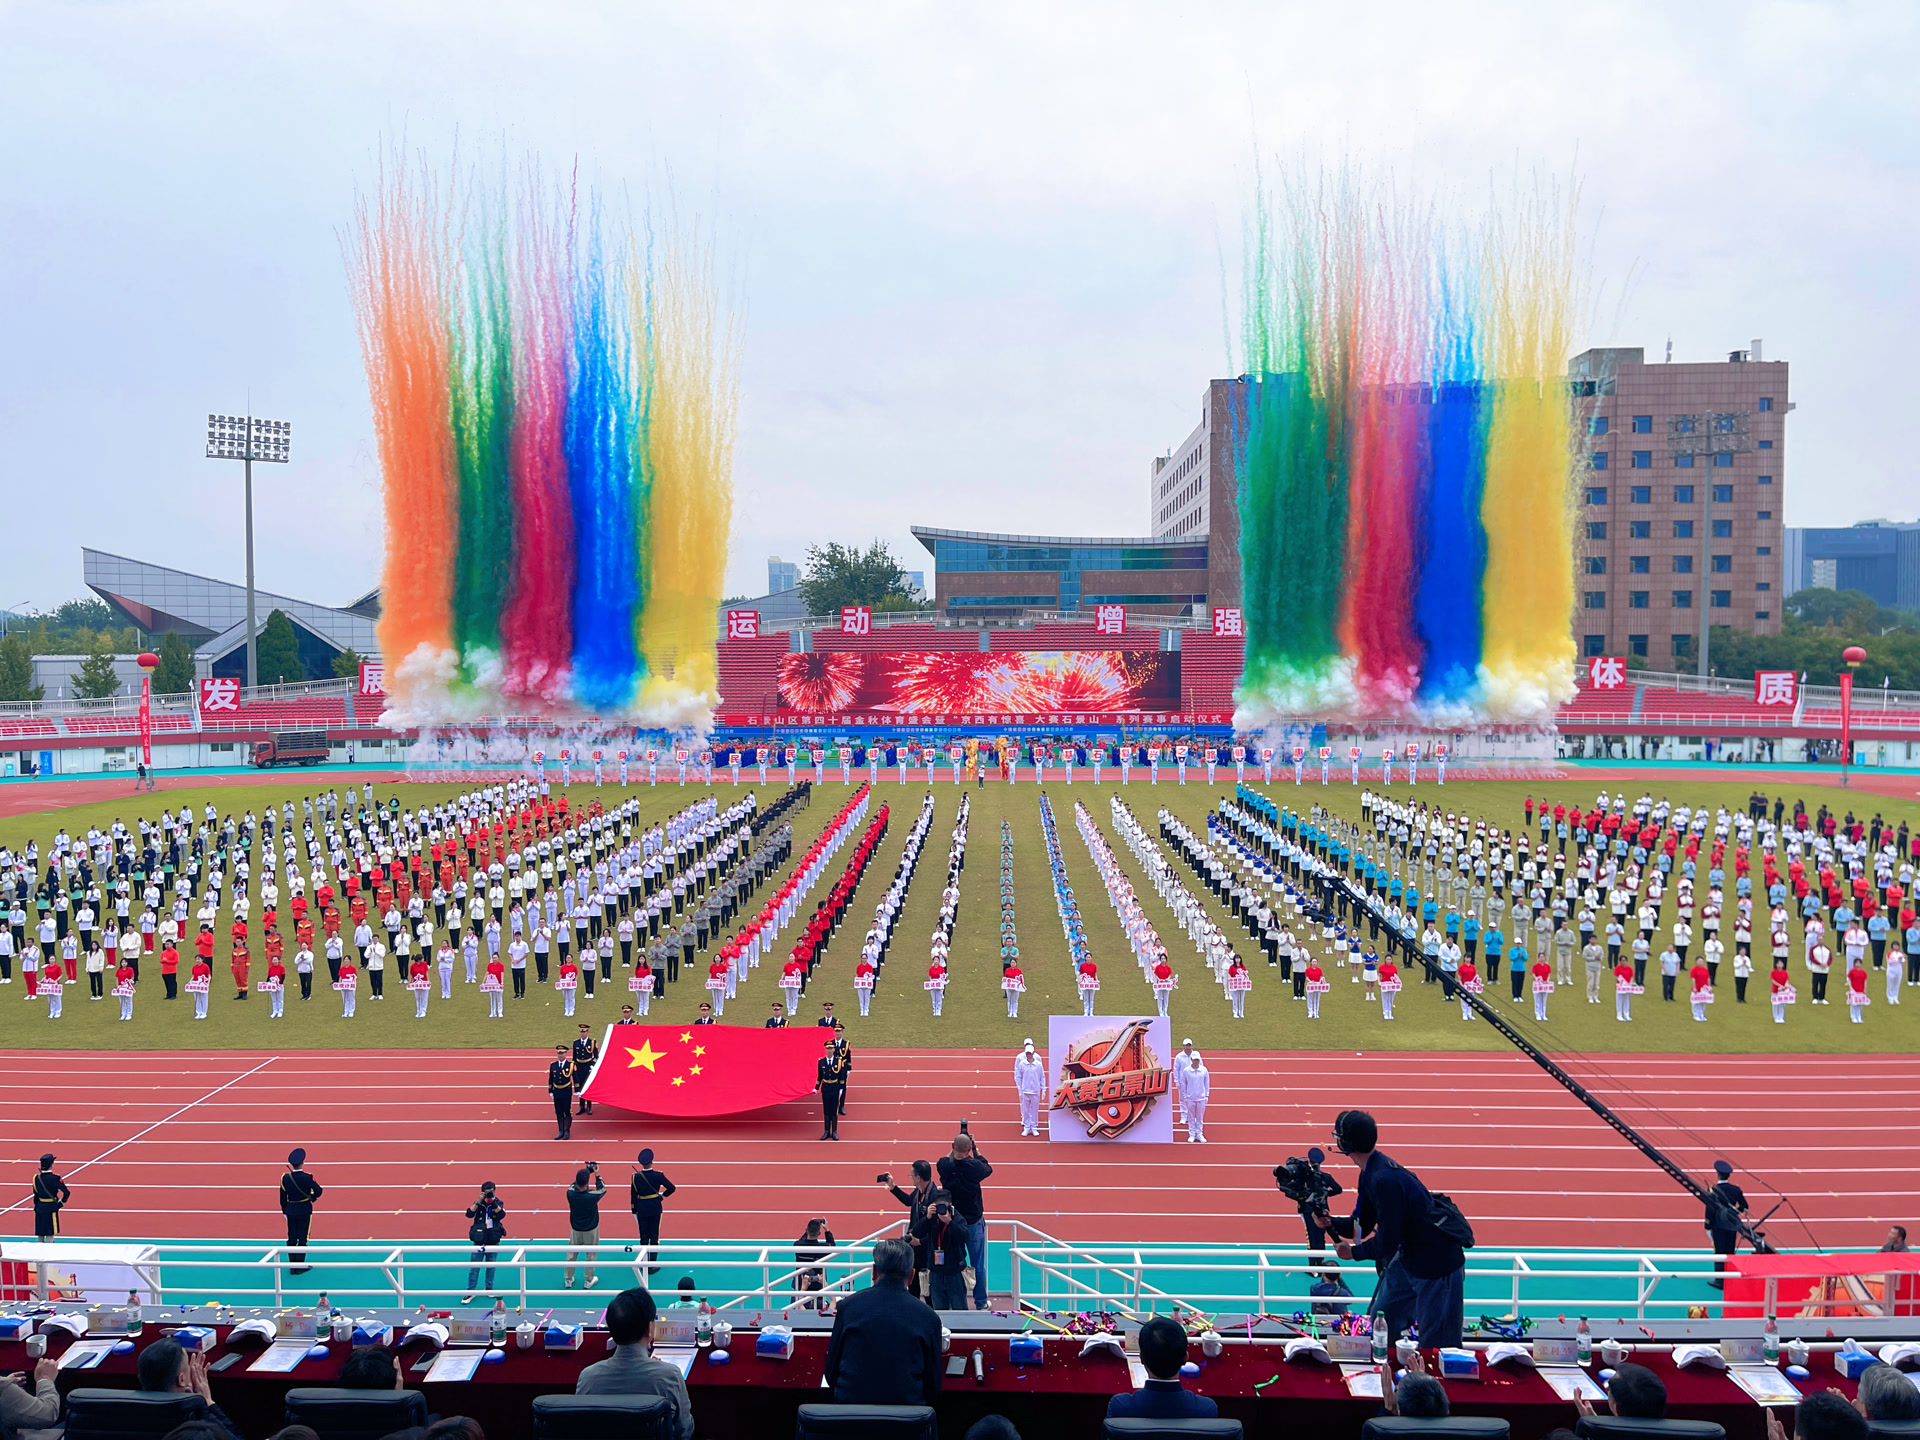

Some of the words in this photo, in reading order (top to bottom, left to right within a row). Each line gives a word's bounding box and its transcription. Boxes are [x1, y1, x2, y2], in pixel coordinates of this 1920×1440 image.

[729, 611, 756, 638] 运
[843, 607, 869, 635] 动
[1097, 606, 1124, 634] 增
[1215, 609, 1242, 636] 强
[1590, 658, 1624, 689] 体
[1757, 673, 1794, 705] 质
[203, 680, 239, 711] 发
[561, 750, 570, 758] 民
[648, 751, 657, 759] 利
[758, 750, 766, 758] 全
[787, 750, 796, 758] 民
[841, 749, 851, 758] 动
[897, 748, 907, 757] 康
[926, 750, 934, 759] 中
[953, 749, 962, 757] 国
[1035, 749, 1044, 757] 康
[1094, 750, 1103, 759] 石
[1150, 751, 1159, 759] 兴
[1178, 748, 1187, 756] 之
[1263, 750, 1272, 759] 身
[1322, 748, 1331, 757] 民
[1409, 746, 1418, 755] 发
[1437, 746, 1446, 755] 展
[536, 752, 544, 761] 全
[618, 751, 628, 760] 身
[678, 752, 688, 760] 国
[702, 753, 711, 761] 利
[731, 755, 739, 763] 民
[814, 751, 824, 760] 运
[1384, 751, 1392, 760] 力
[1055, 1070, 1168, 1107] 大赛石景山
